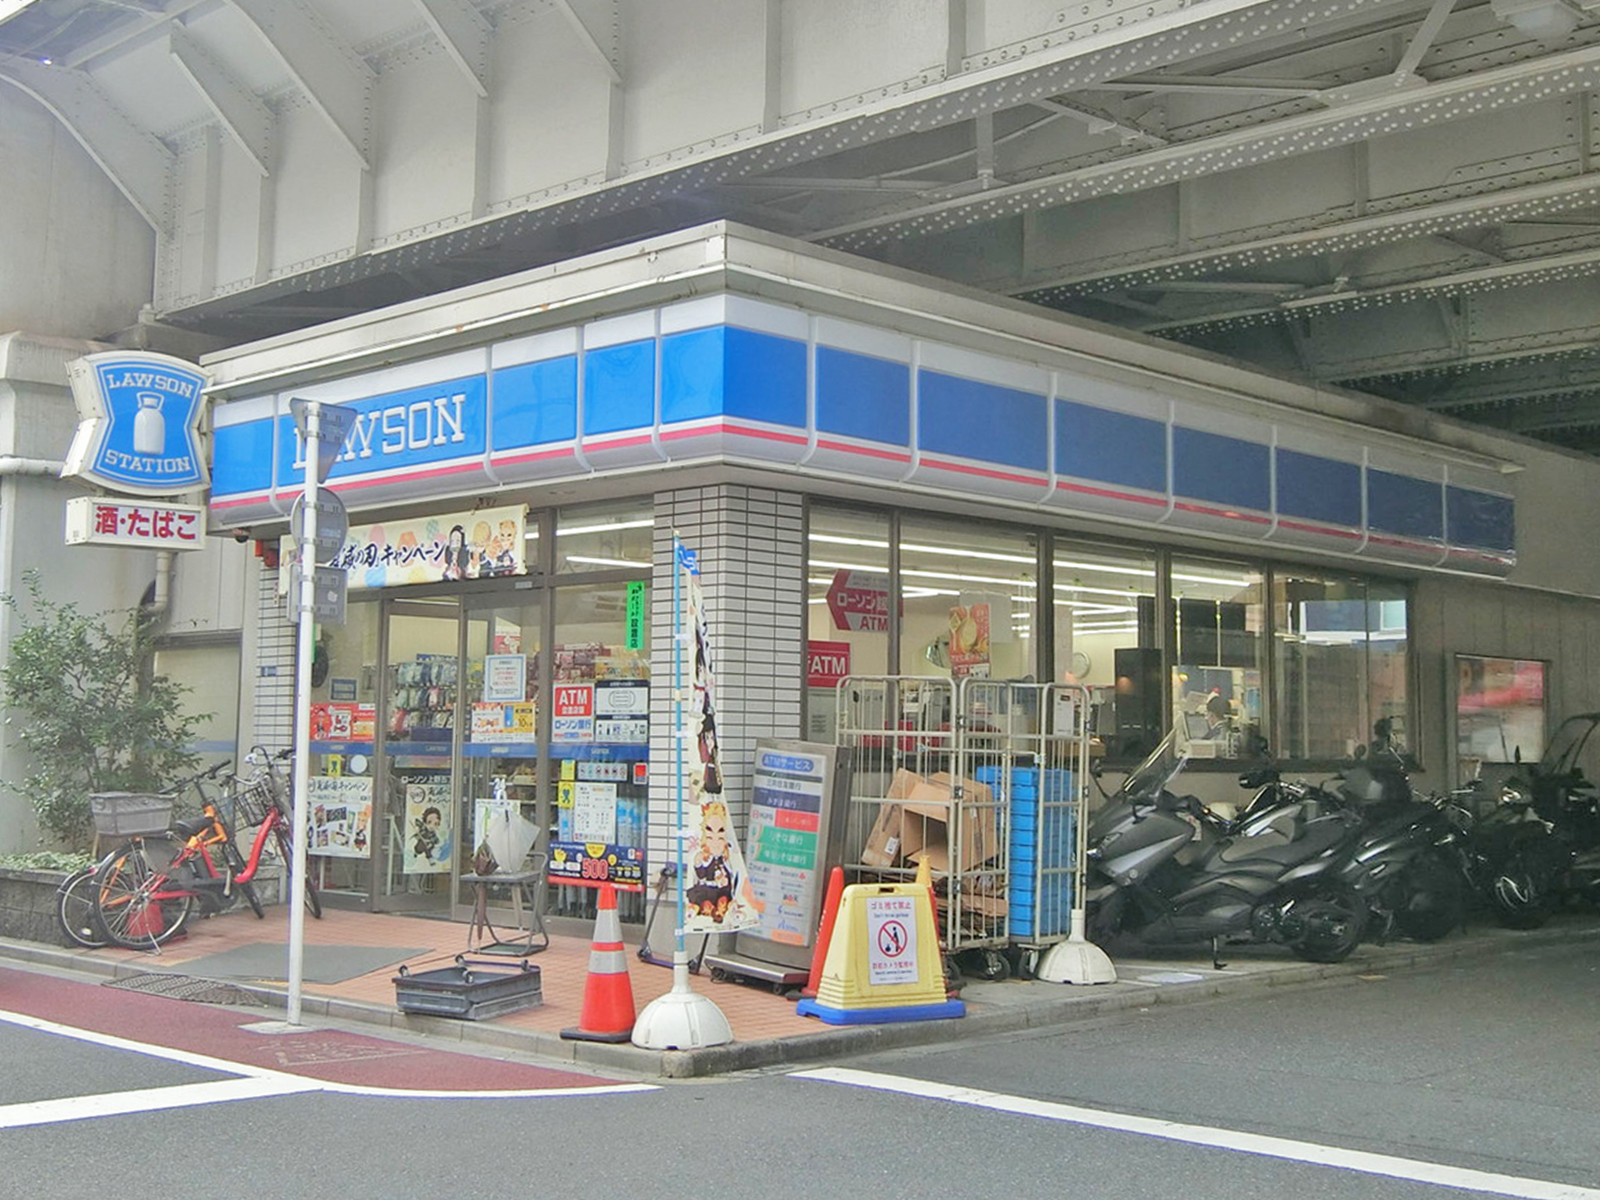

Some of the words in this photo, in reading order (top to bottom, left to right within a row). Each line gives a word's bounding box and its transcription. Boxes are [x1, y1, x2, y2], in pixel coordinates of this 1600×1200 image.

[106, 372, 194, 398] LAWSON
[292, 394, 466, 470] LWSON
[104, 448, 192, 474] STATION
[95, 505, 196, 540] 酒・たばこ
[559, 689, 588, 706] ATM
[582, 857, 608, 880] 500
